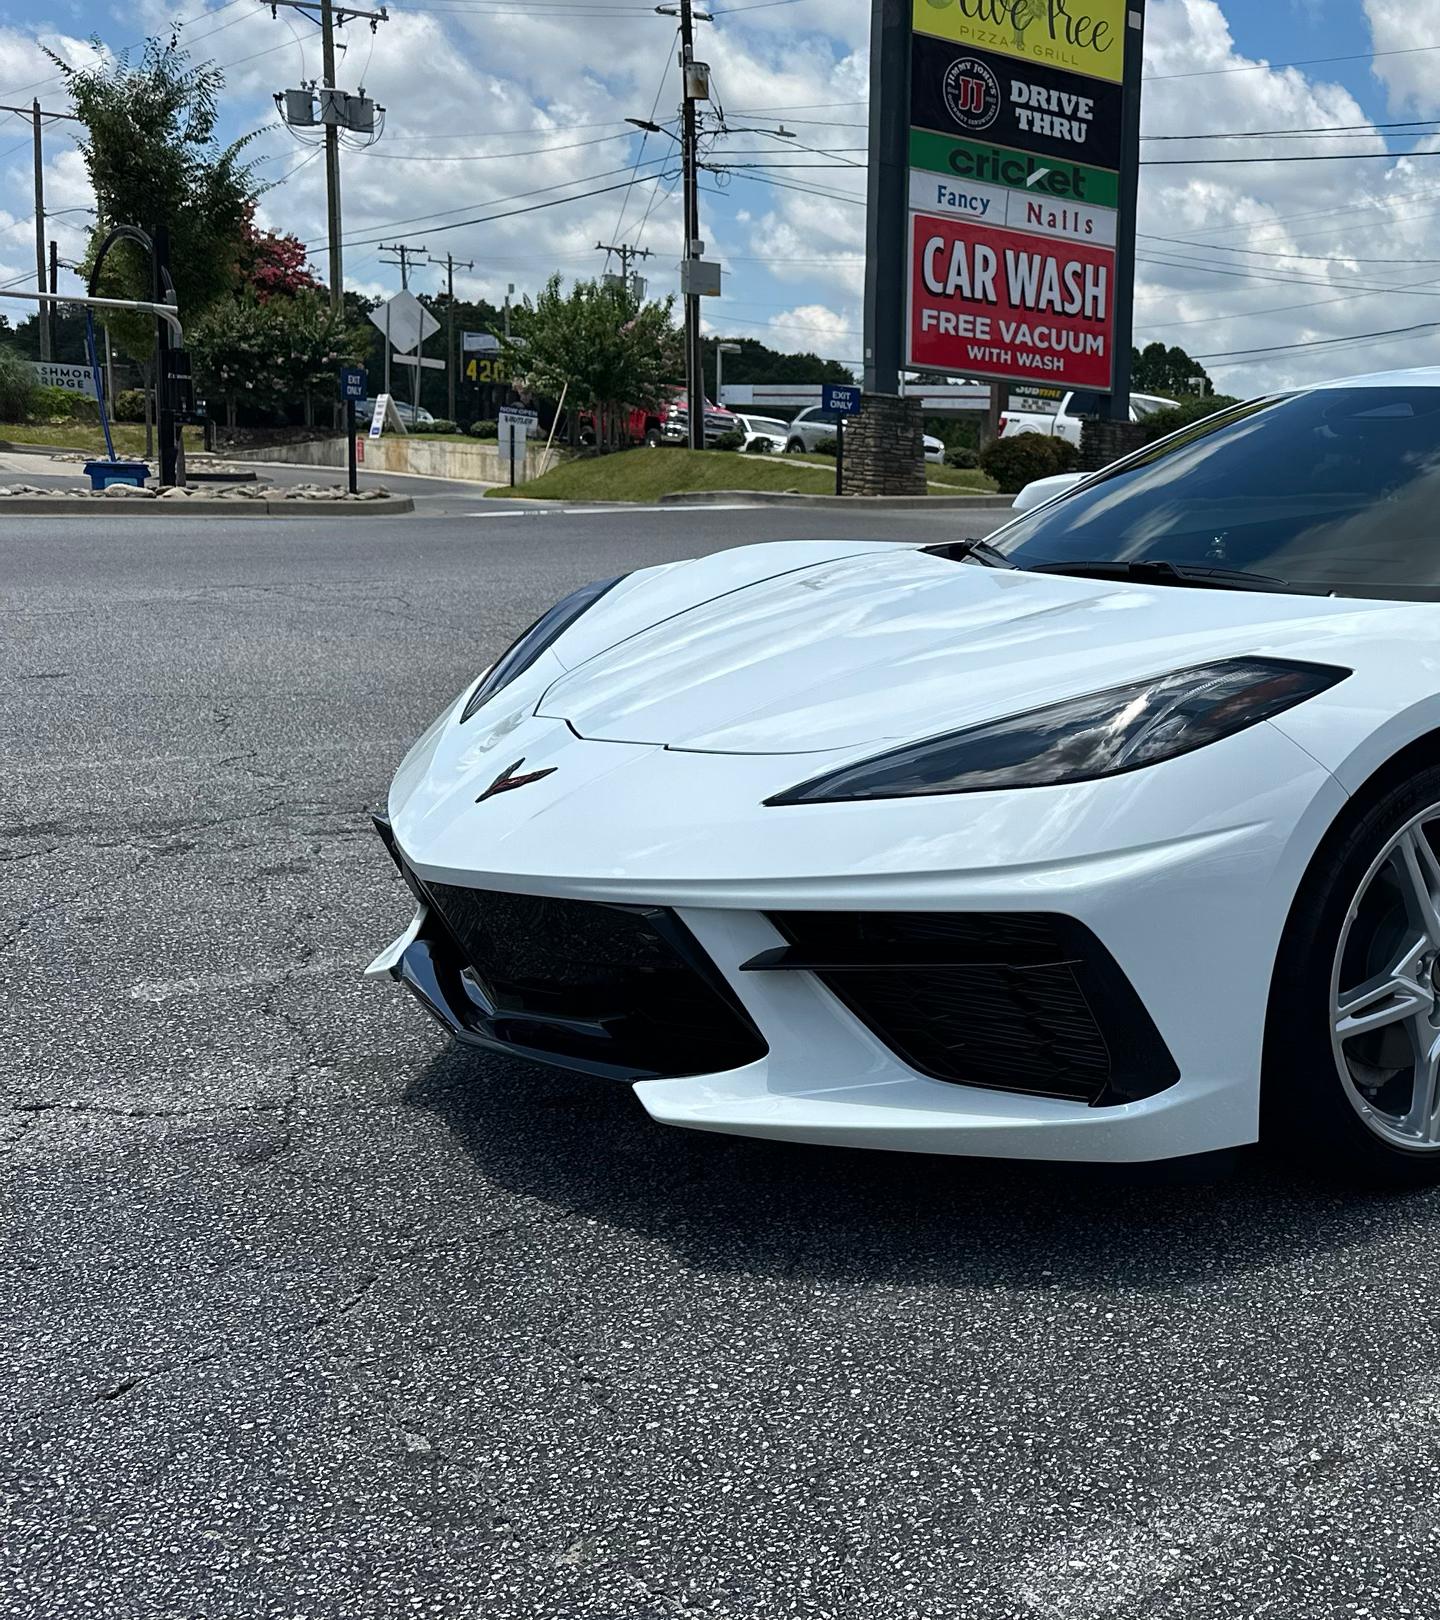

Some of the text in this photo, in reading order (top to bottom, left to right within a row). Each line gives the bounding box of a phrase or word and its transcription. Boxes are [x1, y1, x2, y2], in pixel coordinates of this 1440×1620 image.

[959, 25, 1080, 66] PIZZA & GRILL
[947, 62, 997, 96] JIMMY JOHN'S
[959, 75, 986, 114] JJ
[1010, 79, 1094, 120] DRIVE
[1015, 107, 1087, 143] THRU
[948, 148, 1087, 198] cricket
[937, 184, 1094, 235] Fancy Nails
[922, 235, 1108, 321] CAR WASH
[921, 308, 1105, 357] FREE VACUUM
[967, 345, 1065, 371] WITH WASH
[346, 385, 362, 395] ONLY
[347, 375, 361, 385] EXIT
[832, 390, 851, 400] EXIT
[830, 400, 853, 410] ONLY
